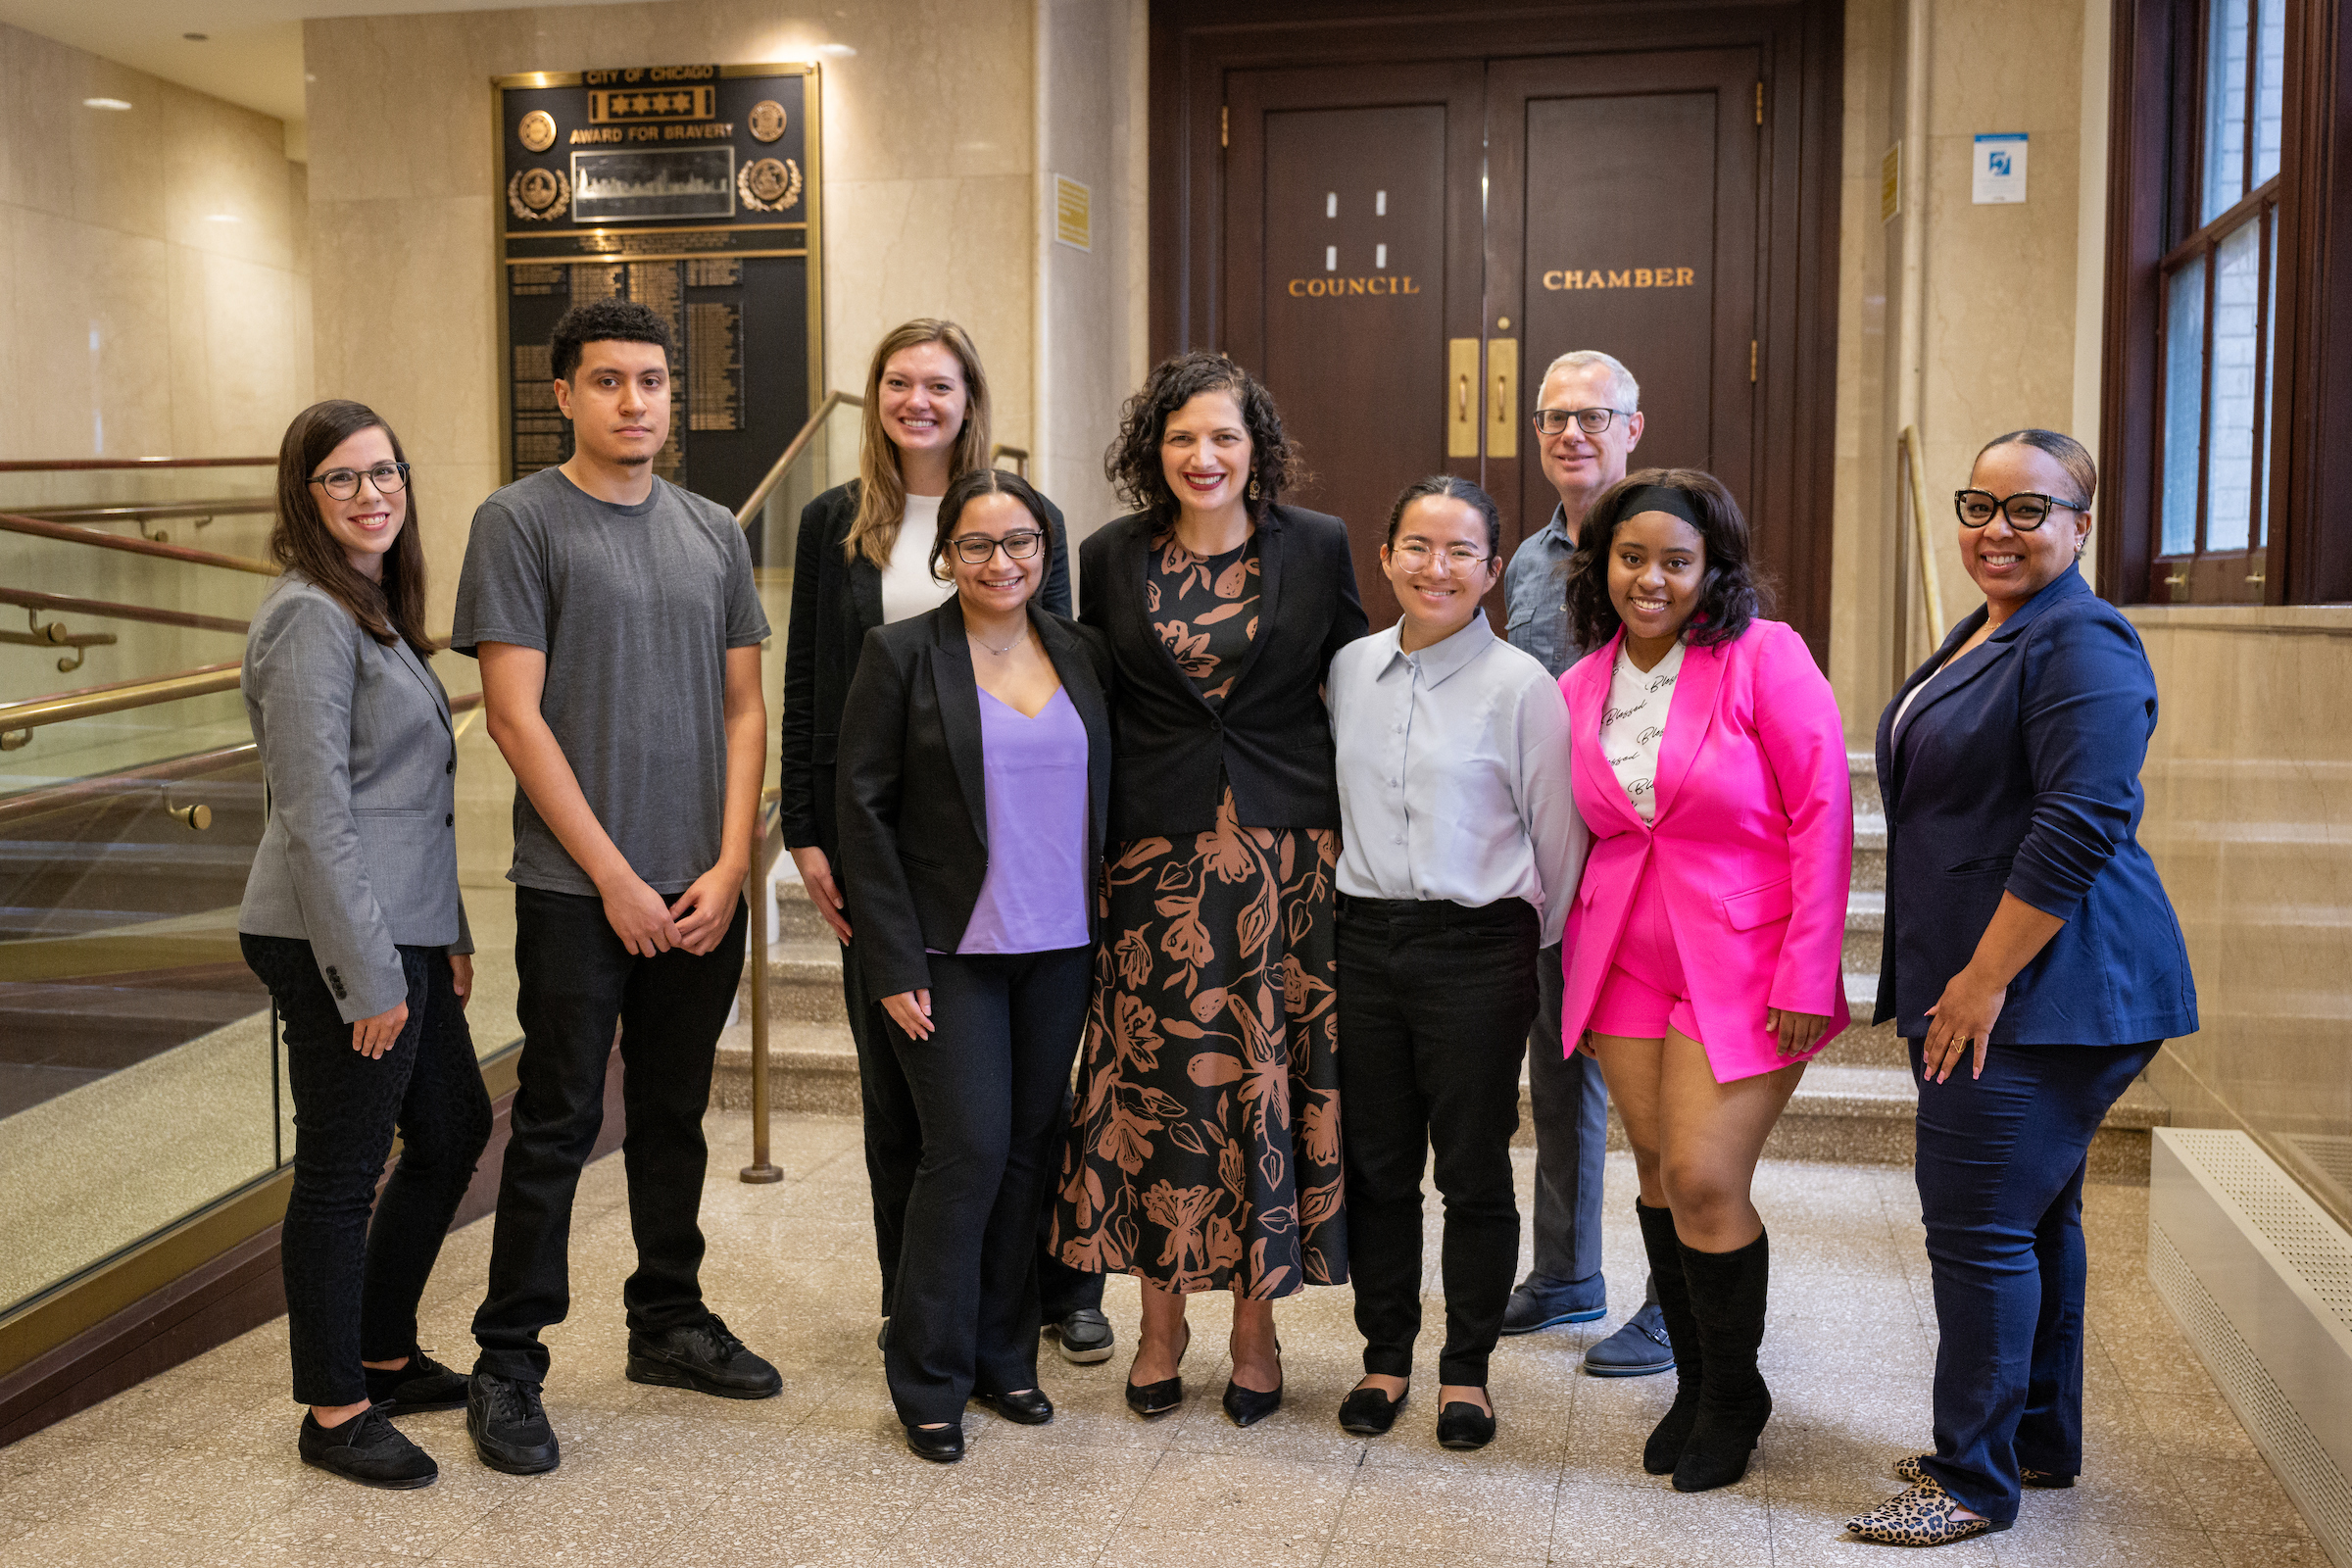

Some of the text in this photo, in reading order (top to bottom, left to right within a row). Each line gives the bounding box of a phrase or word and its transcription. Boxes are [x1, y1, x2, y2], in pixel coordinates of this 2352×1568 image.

[588, 65, 714, 85] CITY OF CHICAGO
[568, 122, 734, 145] AWARD FOR BRAVERY
[1288, 267, 1694, 298] COUNCIL CHAMBER
[1601, 699, 1647, 726] Blessed
